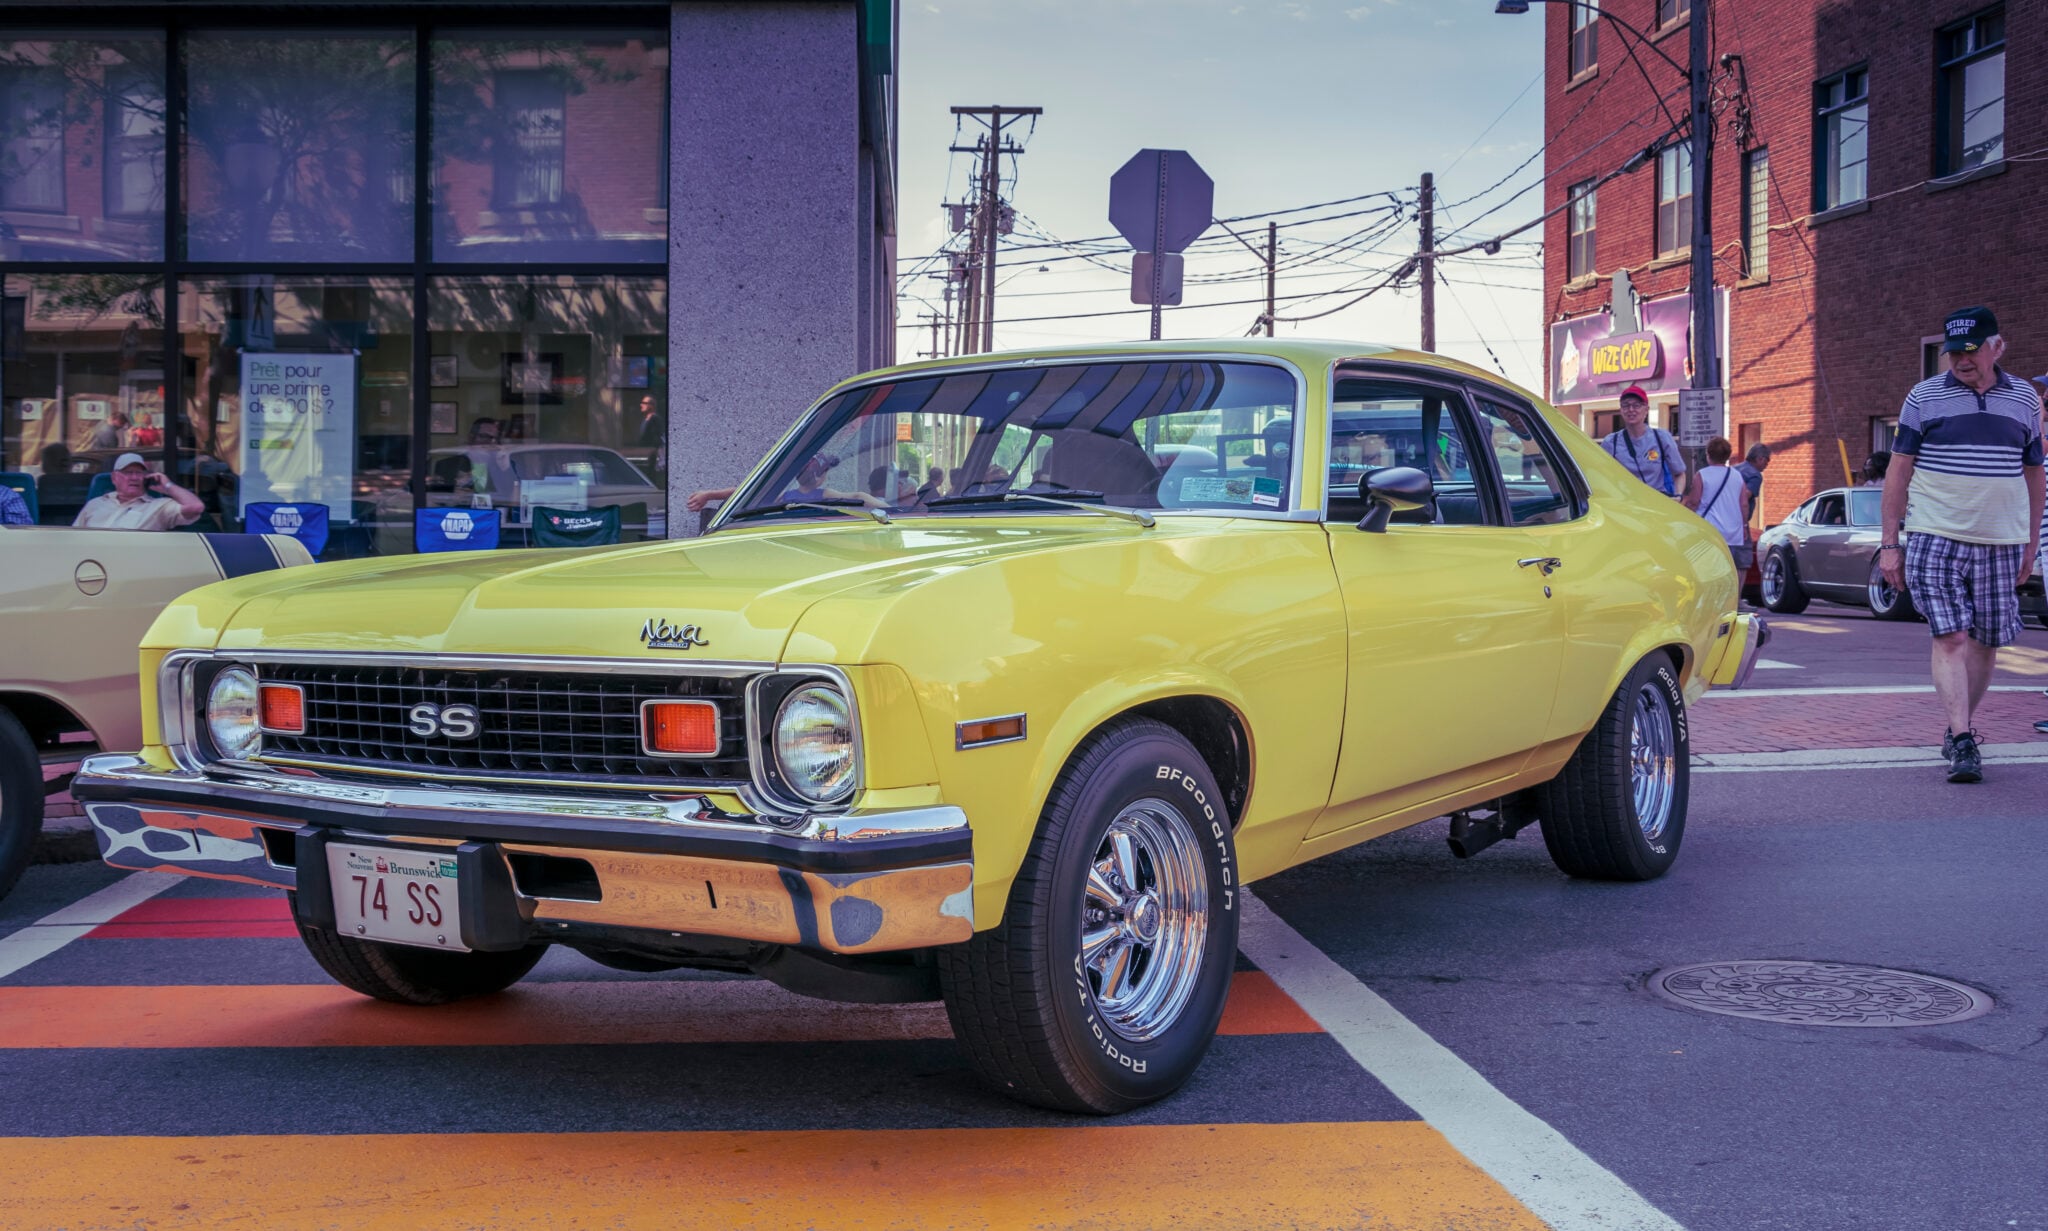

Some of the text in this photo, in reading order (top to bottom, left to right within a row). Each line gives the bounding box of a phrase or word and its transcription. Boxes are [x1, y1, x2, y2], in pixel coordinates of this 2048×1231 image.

[1945, 319, 1976, 330] RETIRED
[1949, 327, 1969, 337] ARMY
[1621, 339, 1652, 371] GUYZ
[250, 362, 322, 379] Prêt pour
[250, 381, 331, 397] une prime
[444, 518, 470, 532] NAPA
[640, 617, 710, 647] Nova
[1657, 667, 1681, 706] Radial
[409, 703, 479, 738] SS
[358, 856, 372, 864] New
[347, 861, 374, 871] Nouveau
[390, 862, 442, 879] Brunswick
[352, 875, 442, 927] 74 SS
[1087, 1015, 1147, 1073] Radial
